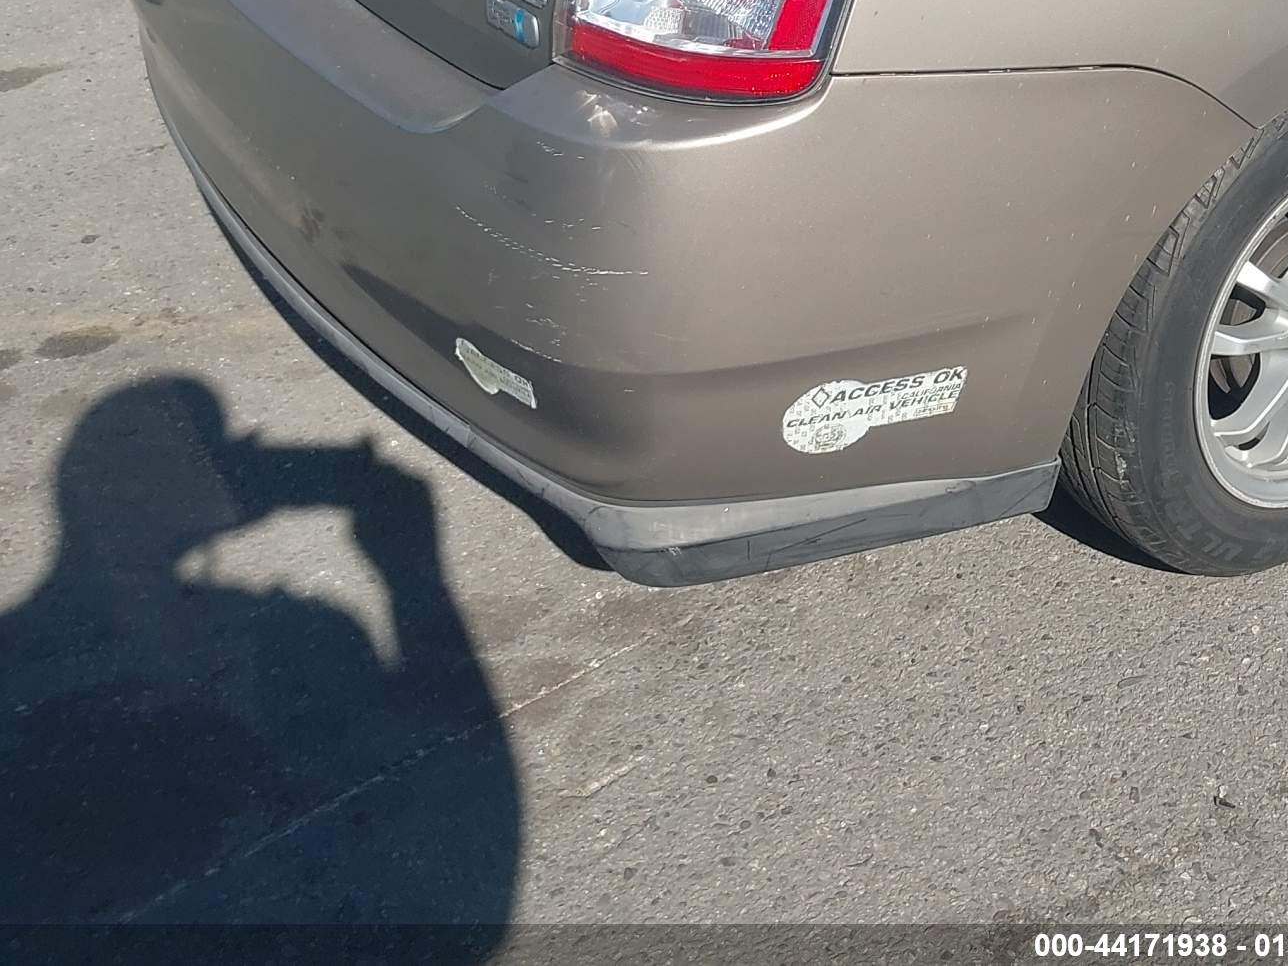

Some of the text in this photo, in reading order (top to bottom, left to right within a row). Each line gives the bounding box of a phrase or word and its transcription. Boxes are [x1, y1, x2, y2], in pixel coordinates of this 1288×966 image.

[830, 367, 963, 404] ACCESS OK
[900, 383, 961, 401] CALIFORNIA
[786, 410, 847, 428] CLEAN
[853, 404, 883, 417] AIR
[890, 390, 960, 411] VEHICLE
